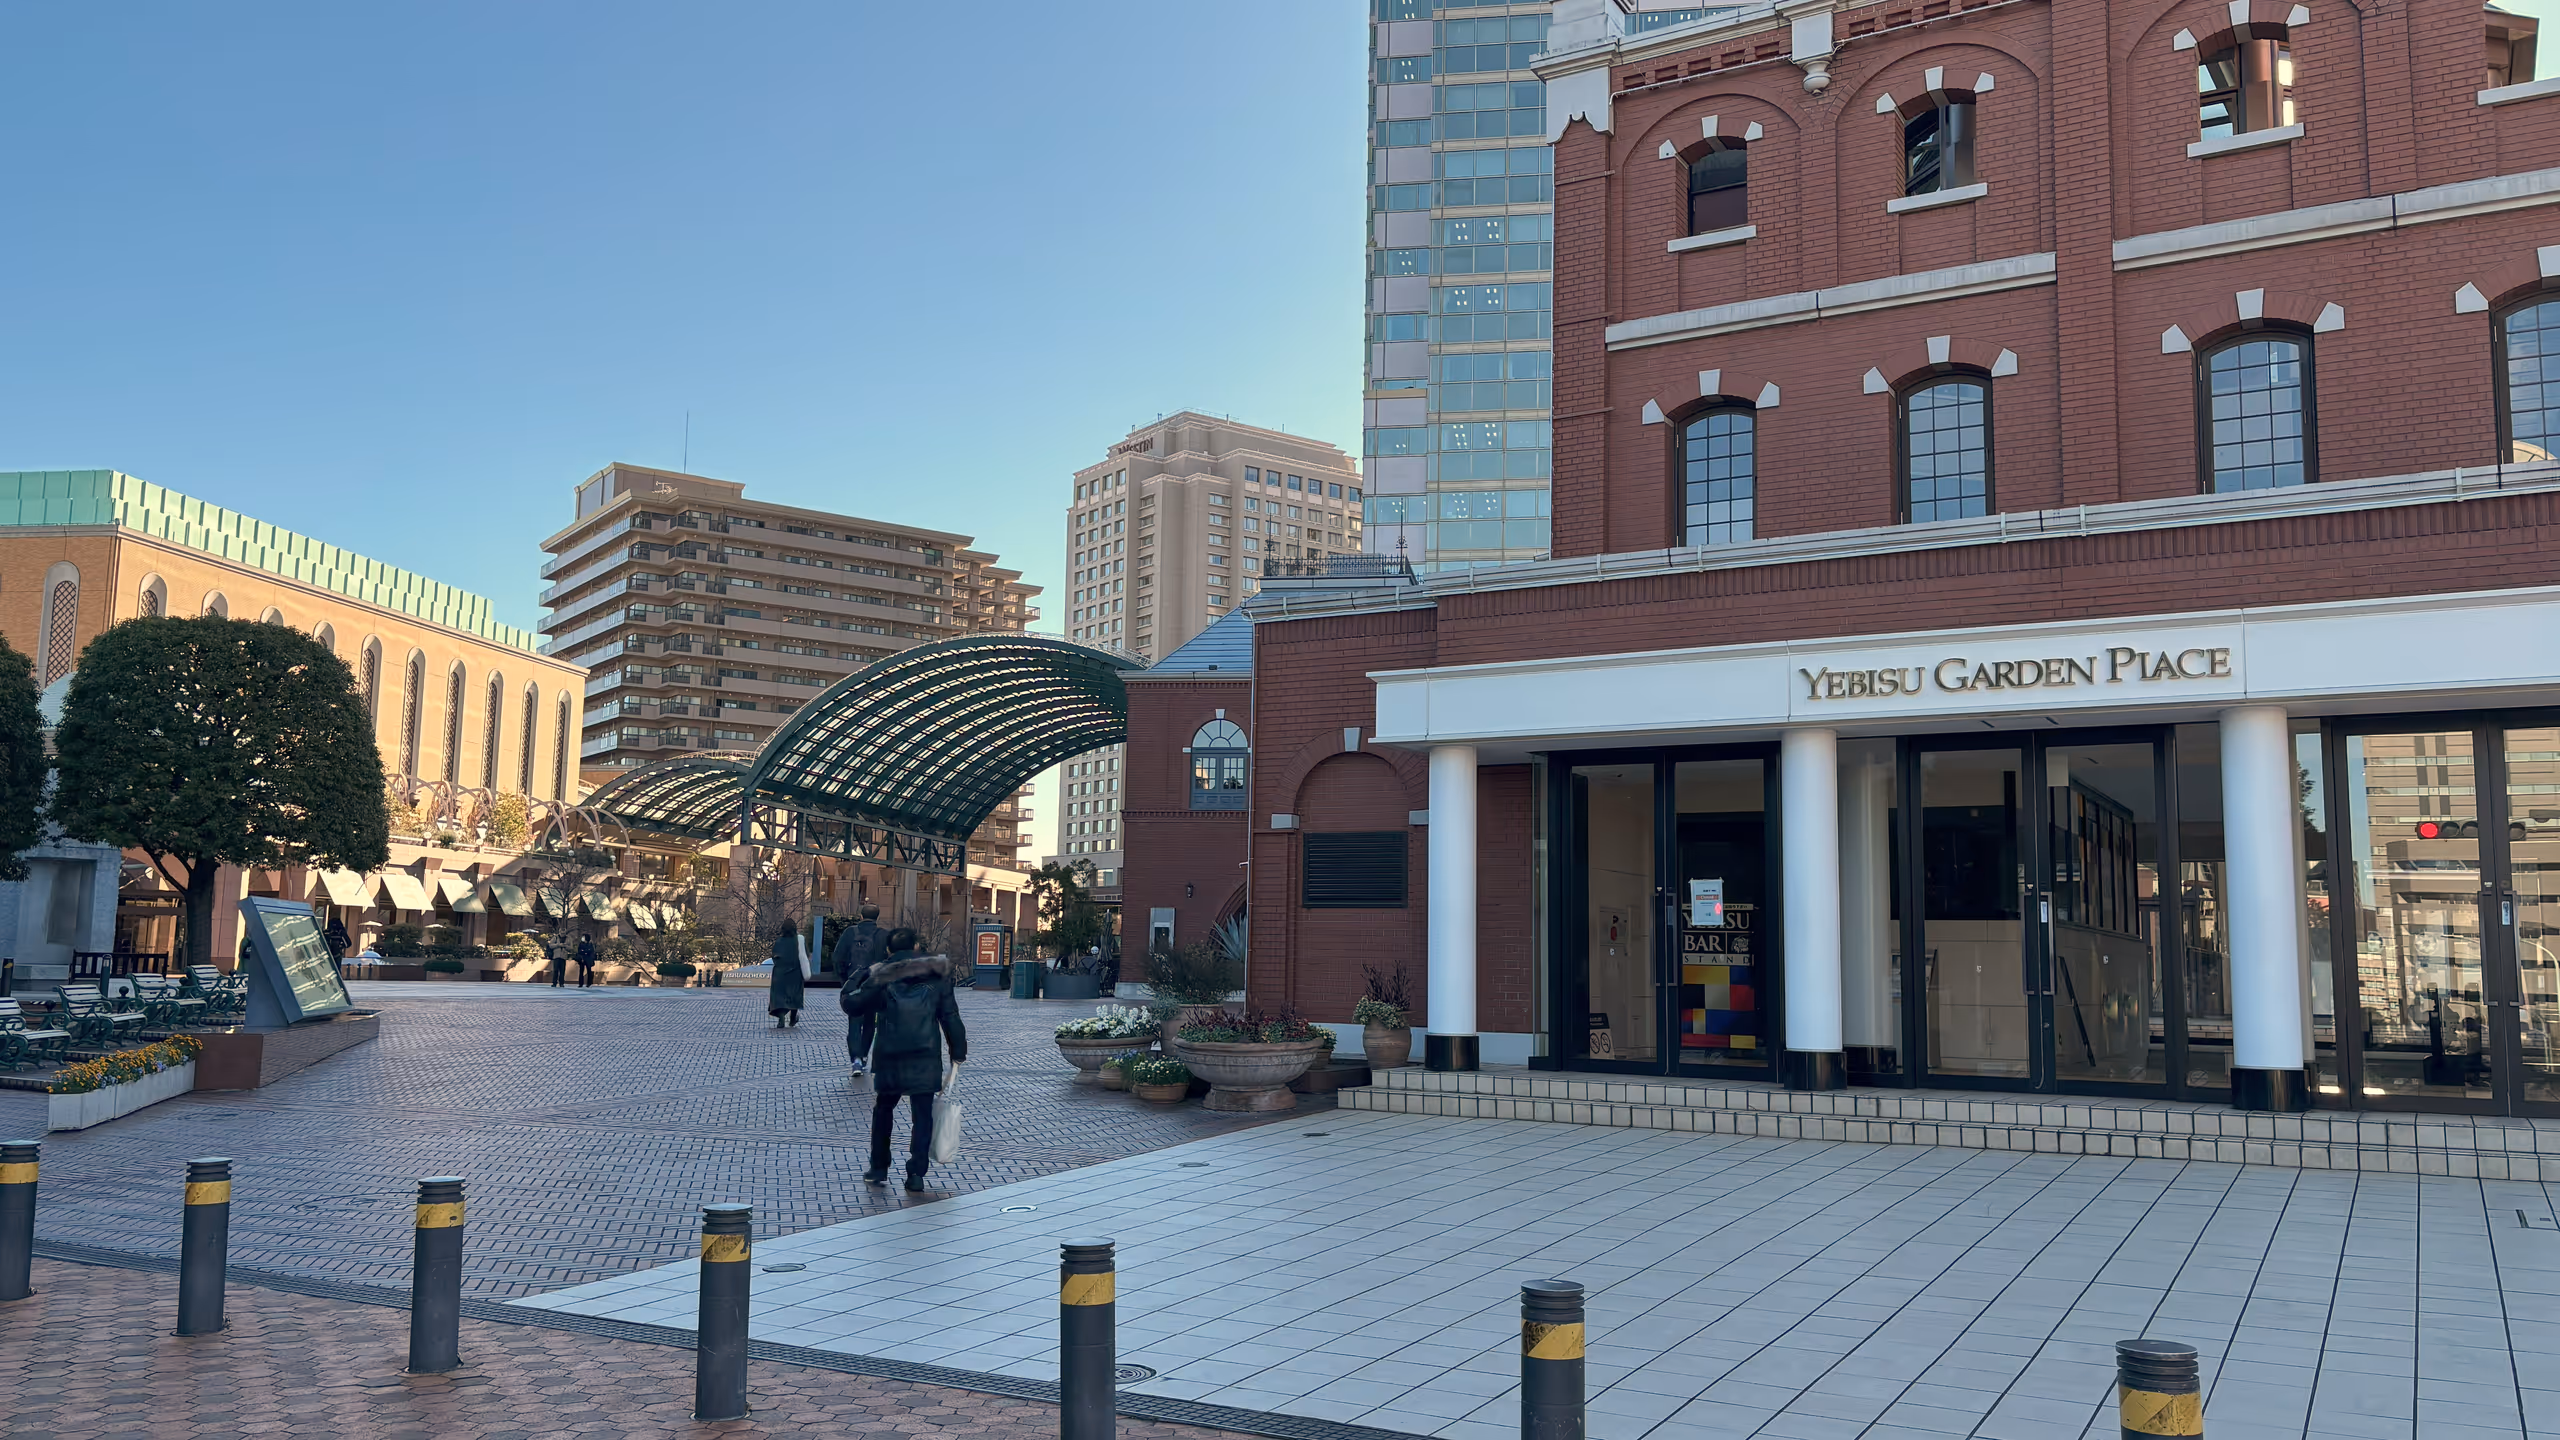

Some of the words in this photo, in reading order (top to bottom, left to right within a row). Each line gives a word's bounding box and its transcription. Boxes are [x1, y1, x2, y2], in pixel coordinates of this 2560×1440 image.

[1799, 666, 1926, 700] YEBISU
[1934, 657, 2097, 692] GARDEN
[2106, 647, 2232, 683] PLACE
[1682, 912, 1750, 929] YSU
[1684, 935, 1724, 952] BAR
[1684, 954, 1750, 964] STAND
